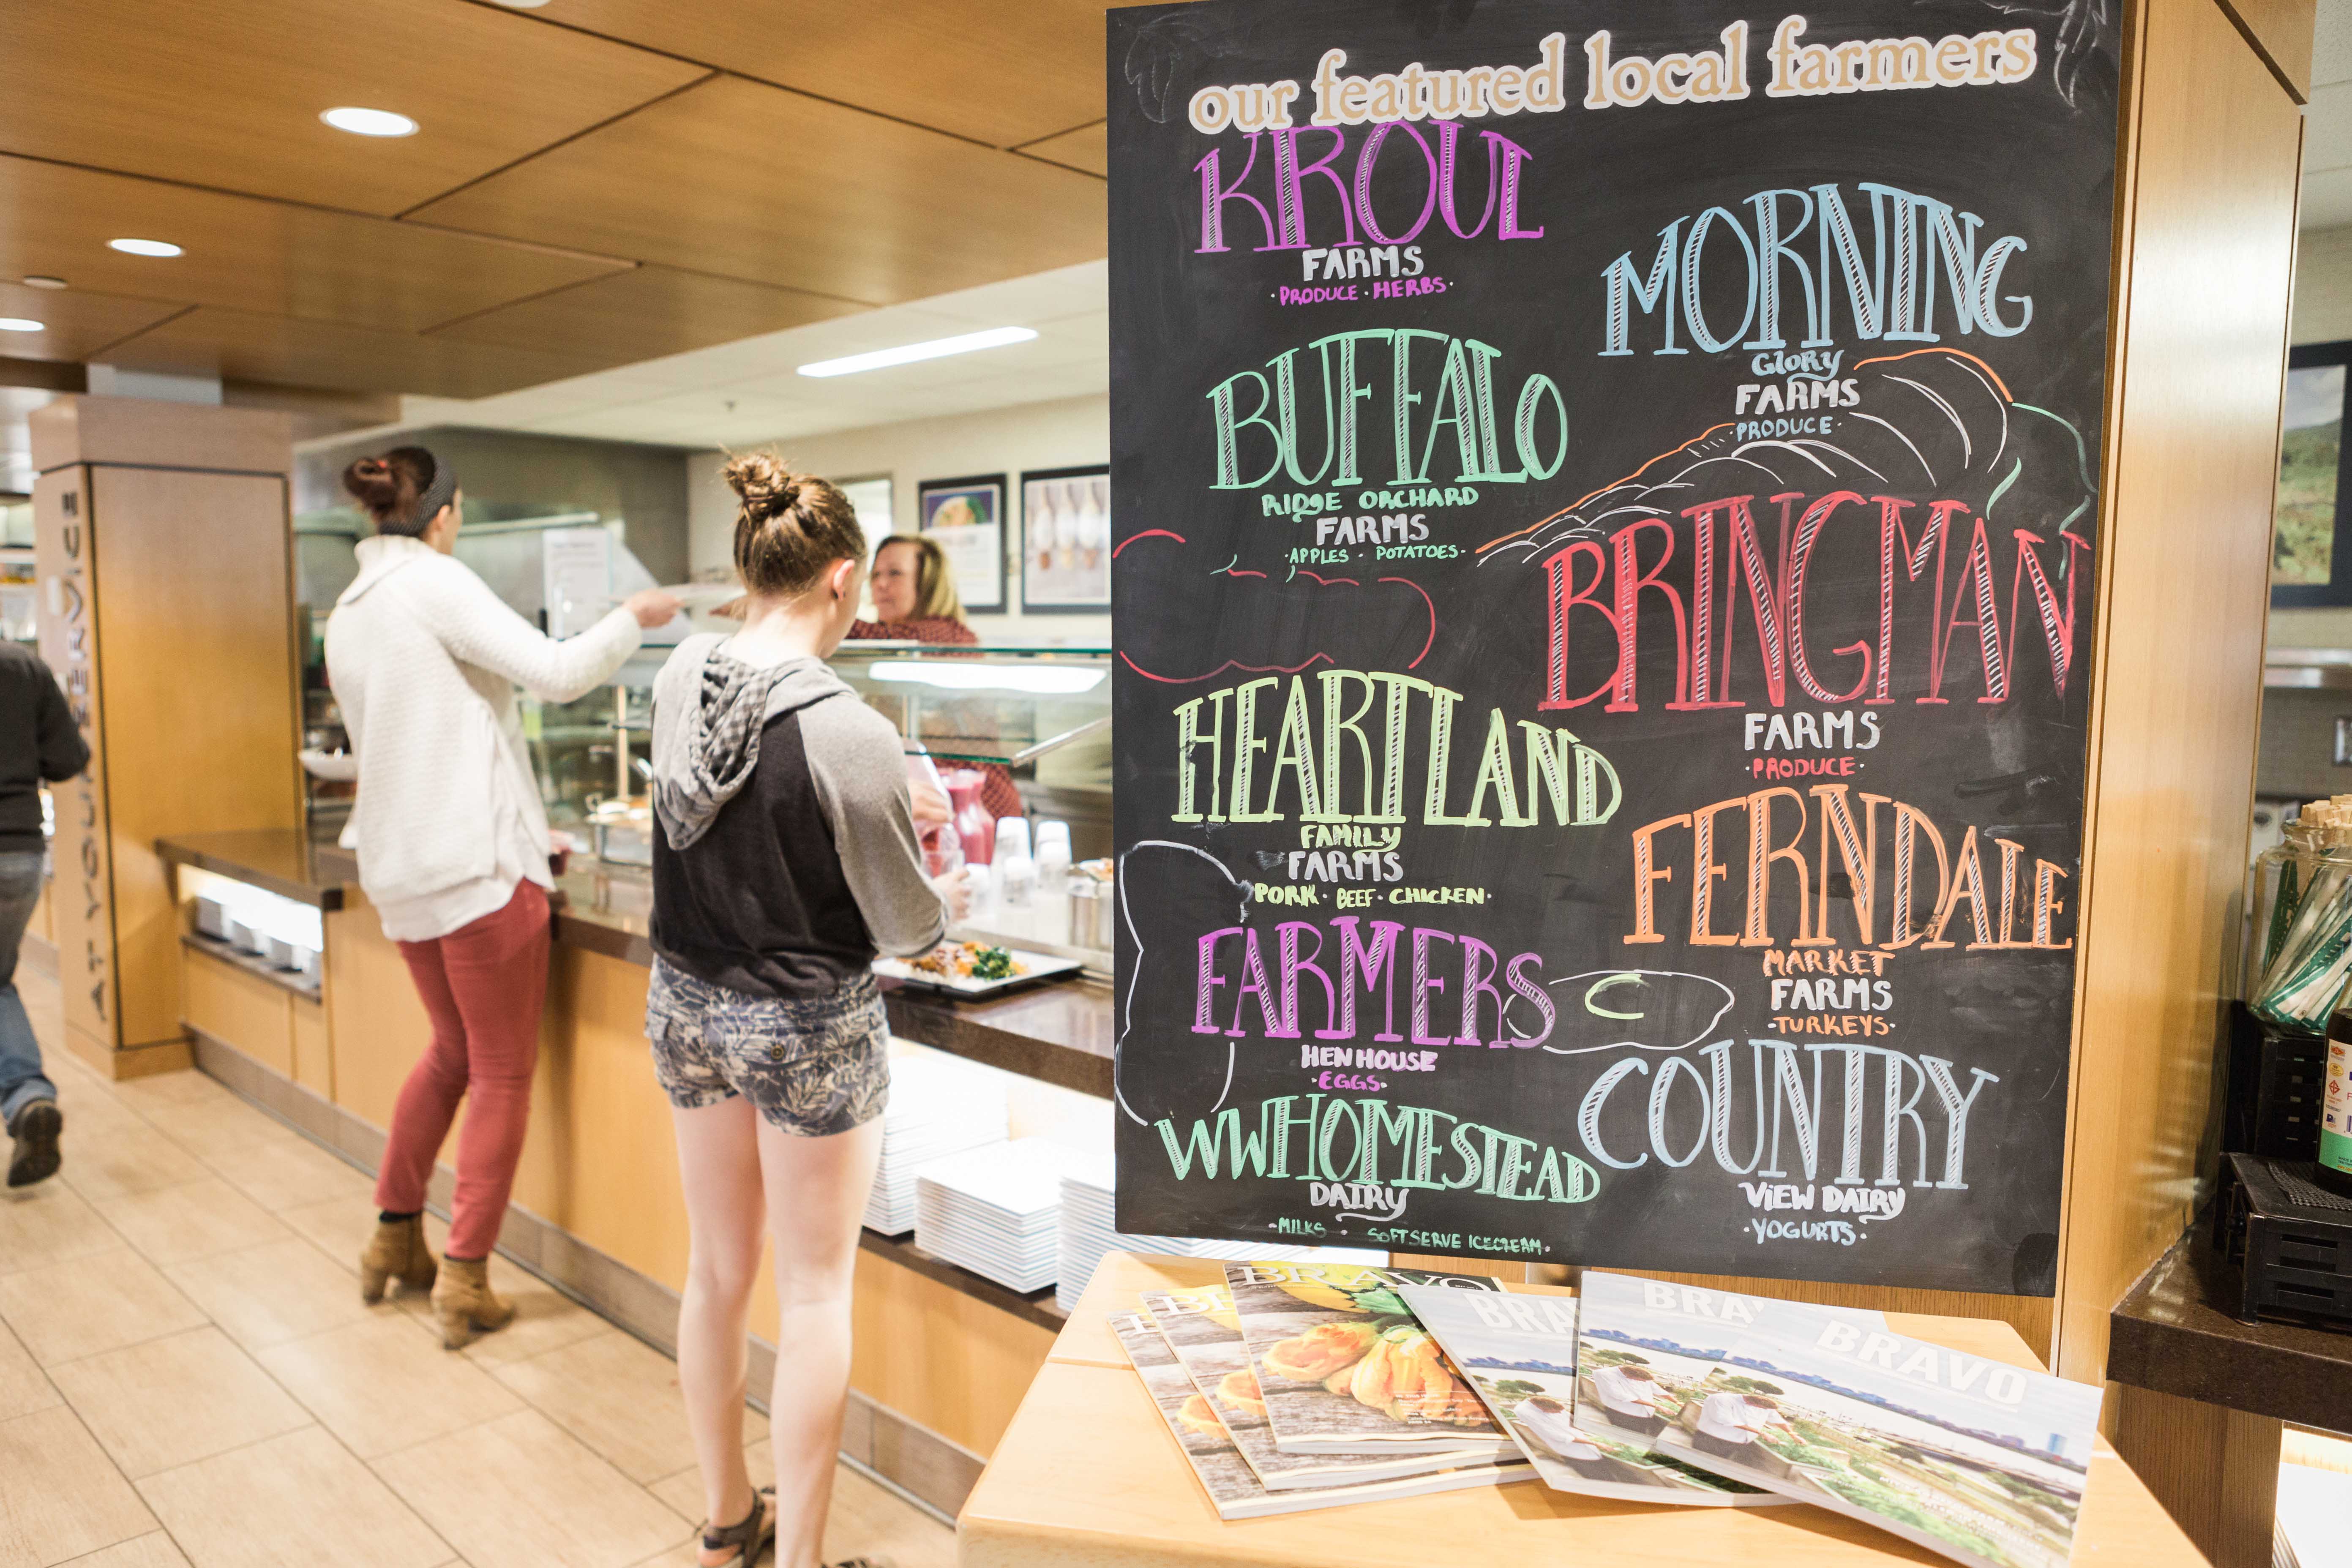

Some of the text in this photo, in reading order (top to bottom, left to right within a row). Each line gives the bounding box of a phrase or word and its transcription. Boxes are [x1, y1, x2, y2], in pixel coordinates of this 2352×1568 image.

[1189, 15, 2036, 134] our featured local farmers
[1194, 120, 1544, 253] KROUL
[1302, 246, 1424, 281] FARMS
[1597, 183, 2033, 356] MORNING
[1280, 277, 1446, 305] PRODUCE HERBS
[1206, 329, 1567, 488] BUFFALO
[1735, 379, 1860, 414] FARMS
[1736, 416, 1833, 442] PRODUCE
[1359, 486, 1479, 509] ORCHARD
[1316, 513, 1430, 545] FARMS
[1289, 545, 1459, 564] APPLES POTATOES
[1538, 491, 2091, 712] BRINGMAN
[1171, 670, 1622, 826] HEARTLAND
[1744, 711, 1880, 750] FARMS
[1753, 756, 1855, 777] PRODUCE
[79, 771, 101, 920] YOU
[1300, 824, 1401, 860] FAMILY
[1288, 850, 1404, 883] FARMS
[1623, 784, 2072, 950] FERNDALE
[1254, 883, 1485, 909] PORK BEEF CHICKEN
[1763, 949, 1896, 977] MARKET
[1191, 916, 1556, 1049] FARMERS
[1771, 978, 1893, 1011] FARMS
[1773, 1014, 1889, 1036] TURKEYS
[1318, 1071, 1381, 1091] EGGS
[1577, 1039, 2000, 1189] COUNTRY
[1310, 1182, 1409, 1222] DAIRY
[1822, 1185, 1906, 1224] DAIRY
[1278, 1217, 1327, 1238] MILKS
[1752, 1218, 1856, 1246] YOGURTS
[1463, 1292, 1578, 1334] BRA
[1644, 1282, 1765, 1325] BRA
[1816, 1319, 2027, 1404] BRAVO
